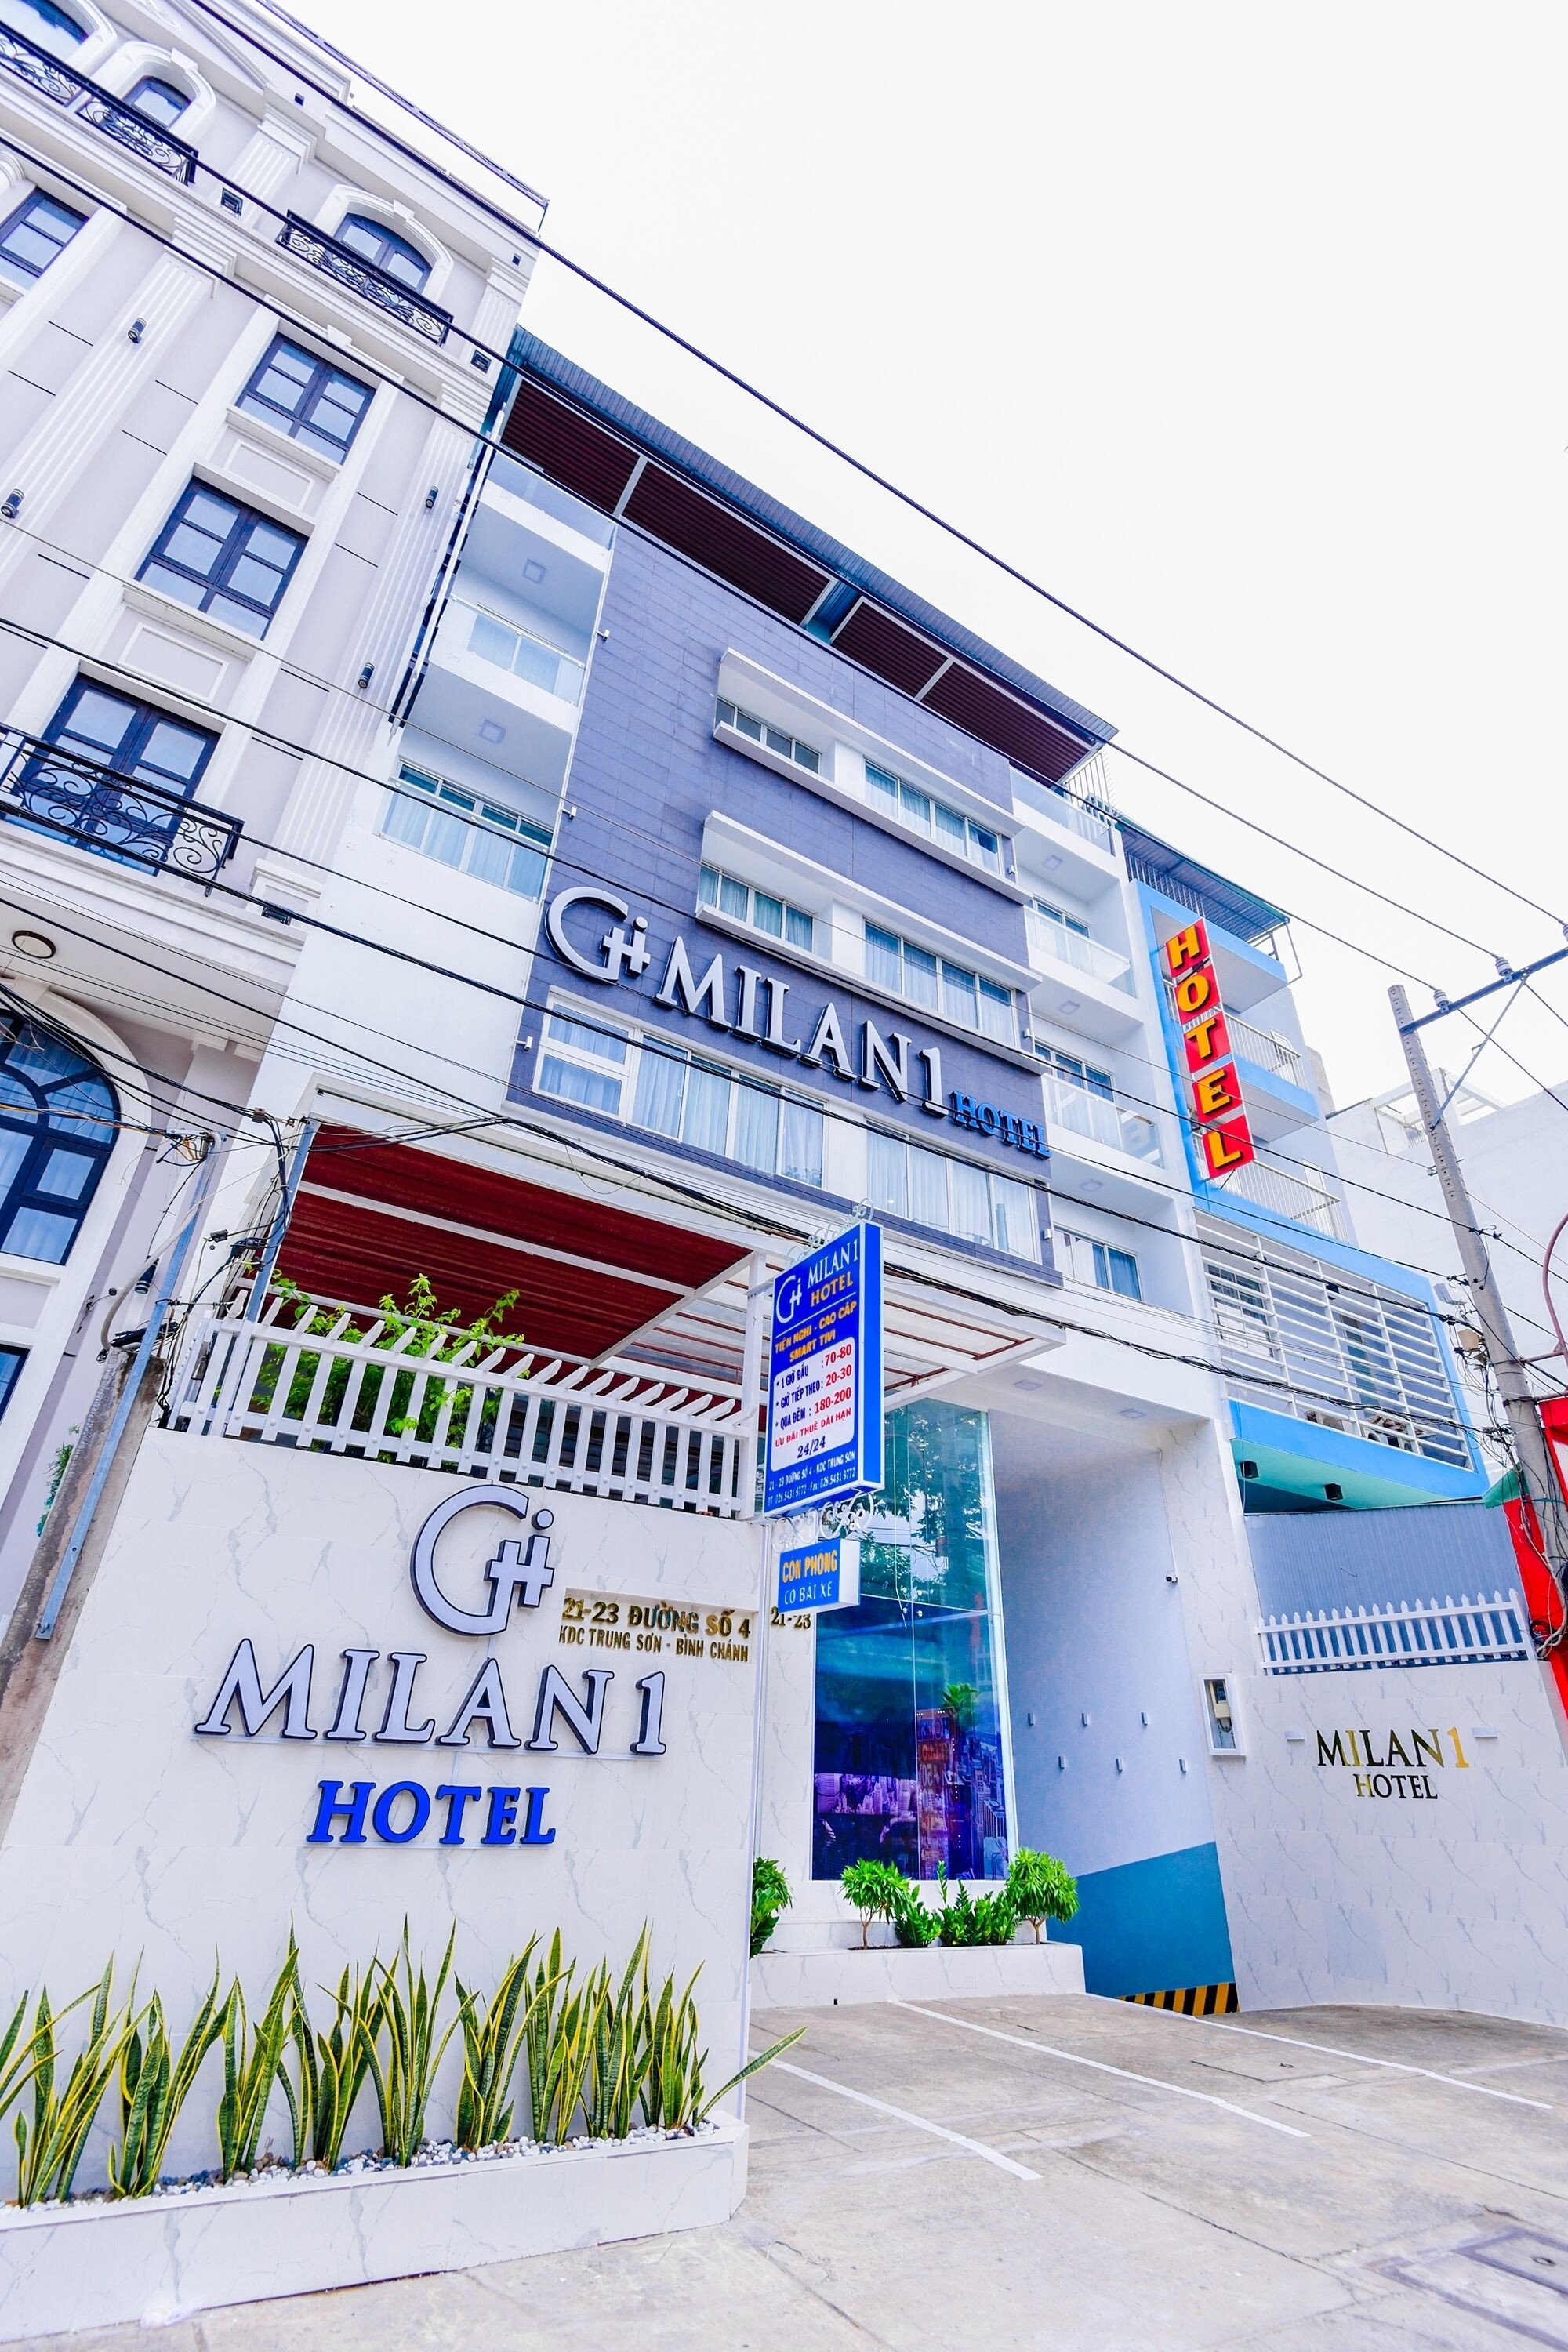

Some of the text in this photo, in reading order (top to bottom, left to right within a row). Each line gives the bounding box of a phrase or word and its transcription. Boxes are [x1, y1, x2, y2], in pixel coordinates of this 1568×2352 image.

[1167, 925, 1242, 1170] HOTEL
[949, 1091, 1051, 1160] HOTEL
[811, 1271, 853, 1307] HOTEL
[818, 1312, 836, 1329] CAO
[789, 1329, 835, 1362] SMART TIVI
[825, 1344, 851, 1366] 70-80
[792, 1385, 804, 1404] TIẾP
[825, 1364, 851, 1387] 20-30
[780, 1417, 791, 1430] QUA
[793, 1407, 805, 1424] ĐÊM
[815, 1387, 851, 1414] 180-200
[800, 1421, 818, 1436] THUÊ
[821, 1416, 833, 1428] DÀI
[836, 1408, 851, 1421] HẠN
[797, 1436, 826, 1458] 24/24
[817, 1461, 826, 1473] KDC
[828, 1455, 844, 1468] TRUNG
[820, 1581, 833, 1598] XE
[562, 1597, 750, 1639] 21-23 ĐƯỜNG SỐ 4
[559, 1625, 585, 1645] KDC
[589, 1628, 630, 1650] TRUNG
[637, 1632, 662, 1653] SƠN
[676, 1634, 704, 1657] BÌNH
[710, 1639, 749, 1662] CHÁNH
[1353, 1773, 1438, 1799] HOTEL
[307, 1780, 557, 1846] HOTEL
